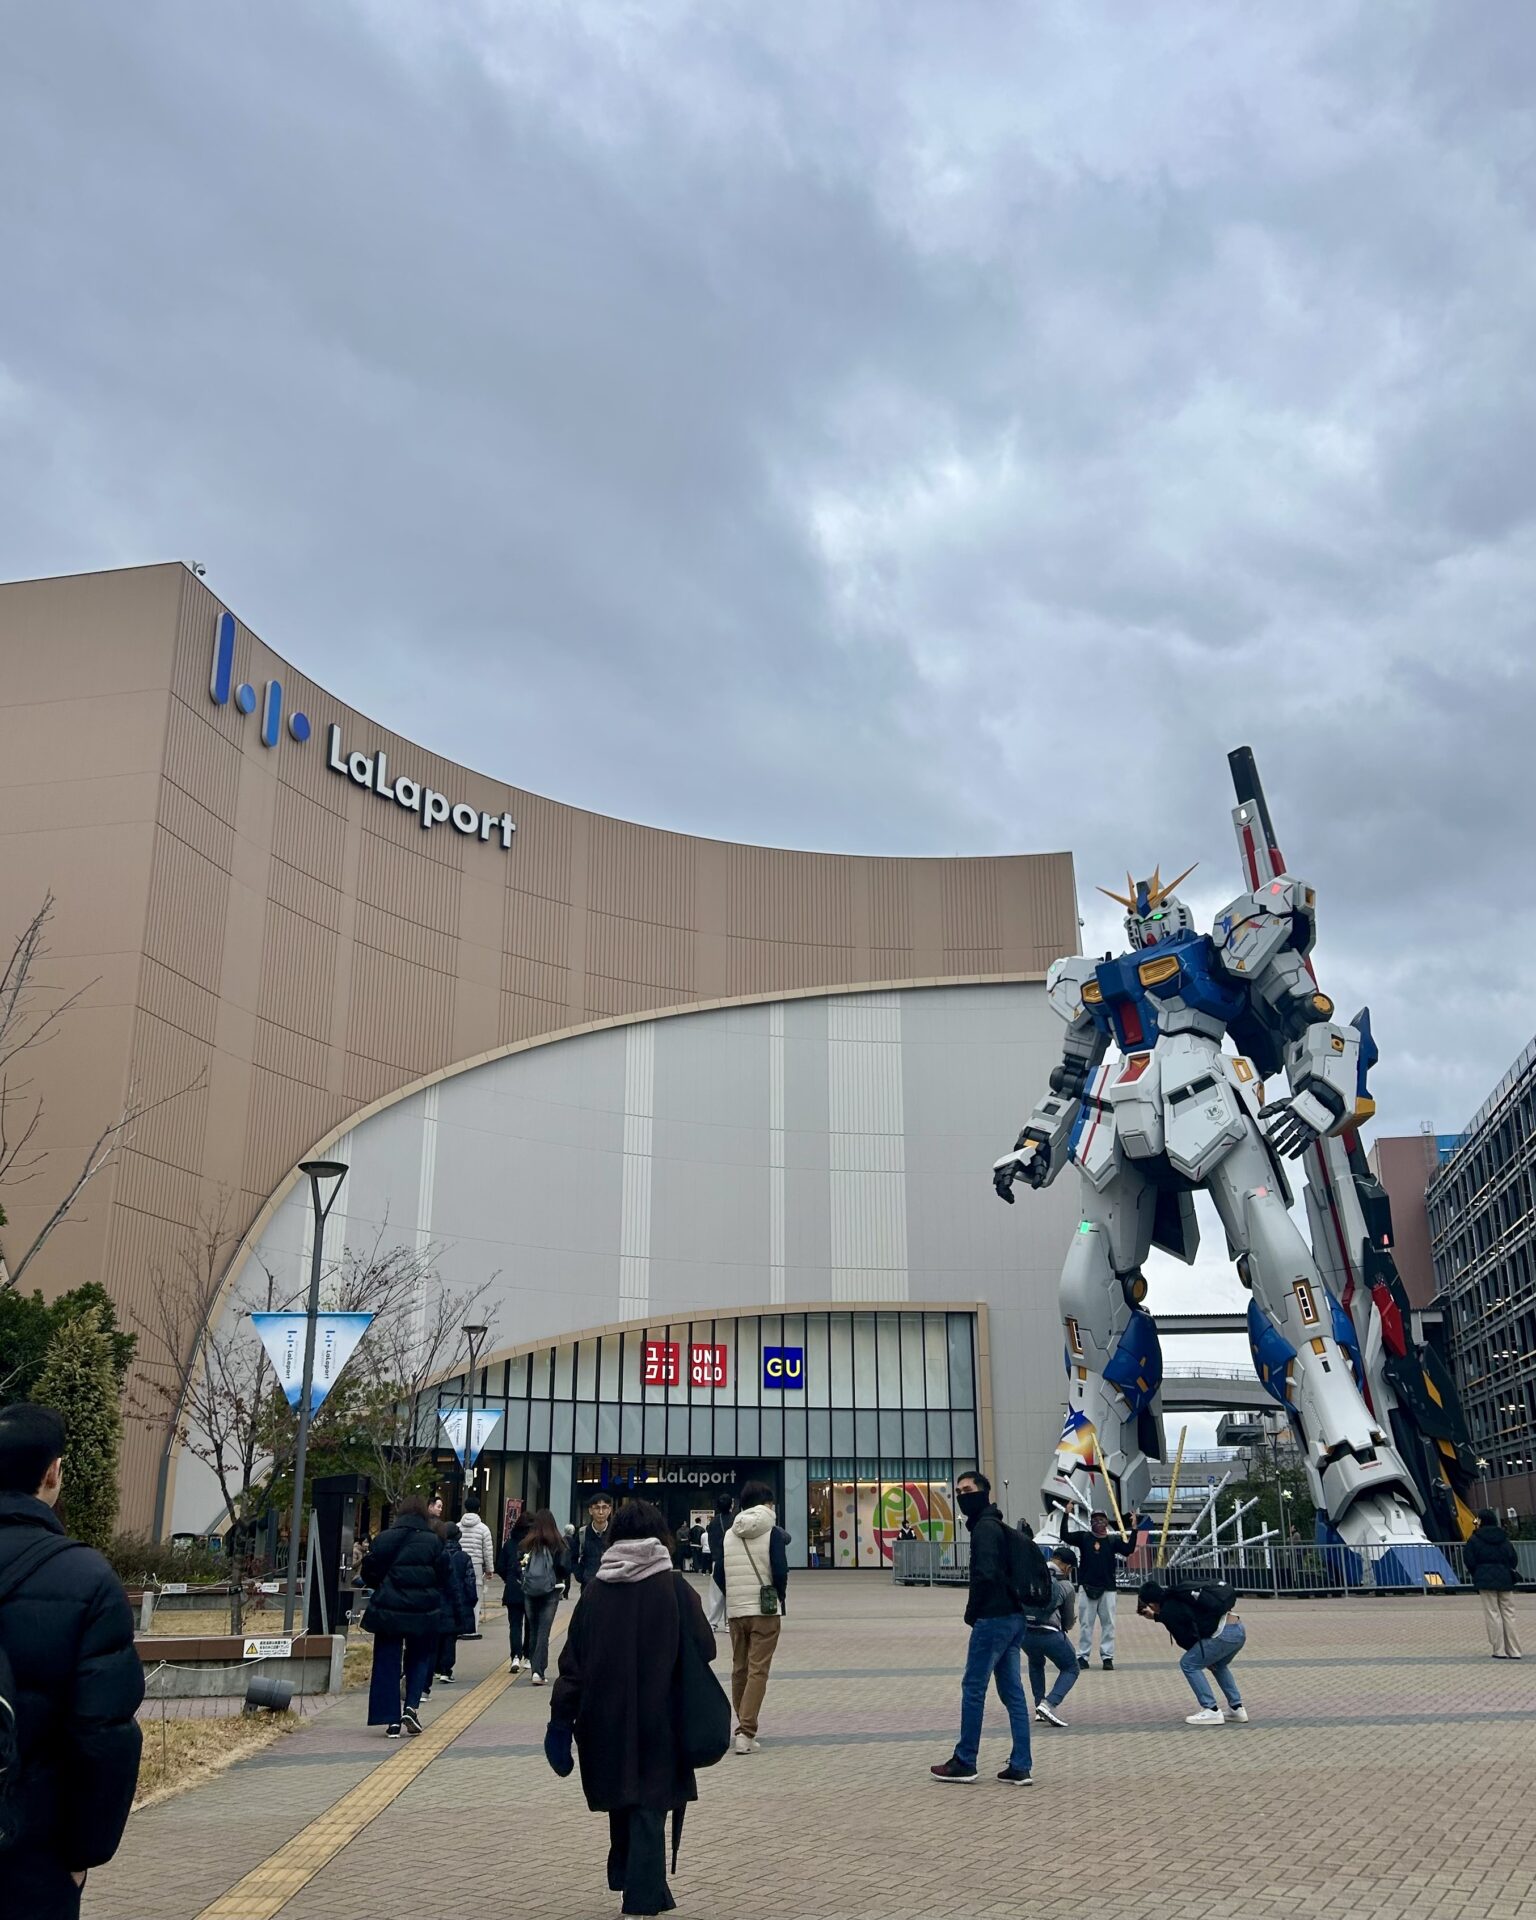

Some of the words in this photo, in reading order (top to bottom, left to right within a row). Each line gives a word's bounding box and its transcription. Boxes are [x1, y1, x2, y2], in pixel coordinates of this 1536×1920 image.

[327, 723, 517, 849] LaLaport
[692, 1349, 721, 1364] UNI
[692, 1366, 723, 1383] QLO
[766, 1357, 801, 1378] GU
[658, 1467, 736, 1488] LaLaport
